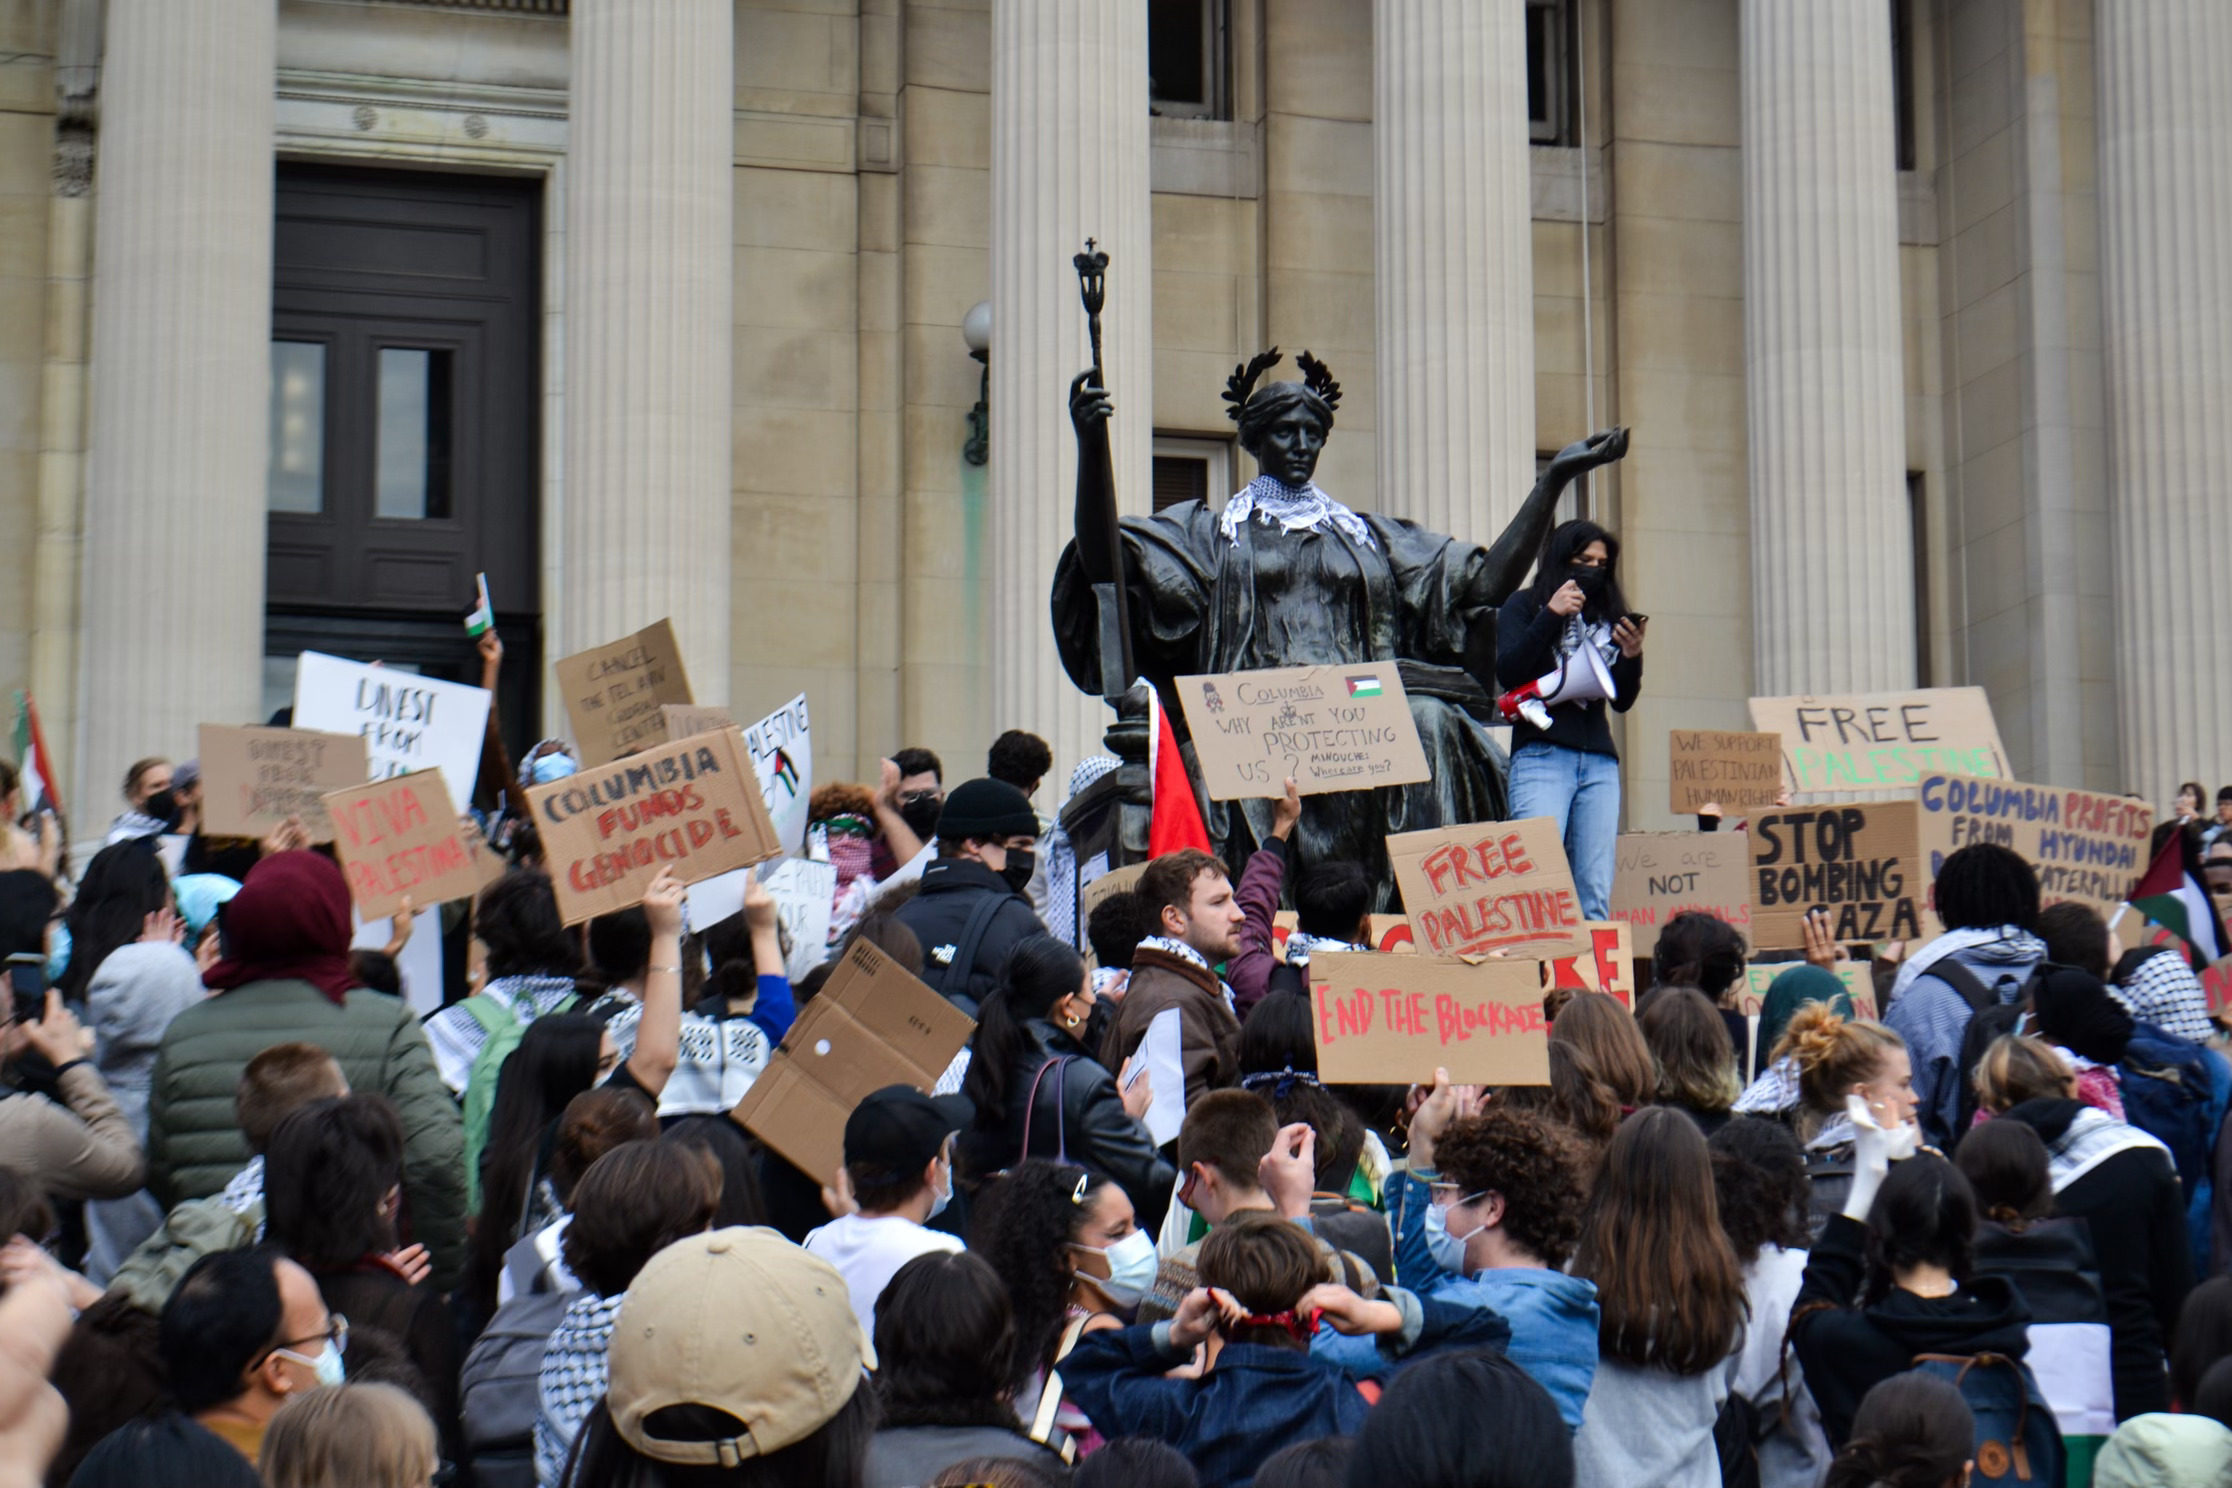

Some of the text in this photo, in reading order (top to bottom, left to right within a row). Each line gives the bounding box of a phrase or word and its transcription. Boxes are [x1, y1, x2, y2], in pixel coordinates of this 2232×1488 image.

[356, 677, 439, 725] DIVEST
[607, 682, 636, 701] TEL
[1237, 681, 1325, 706] COLUMBIA
[746, 699, 809, 764] ALESTINE
[1216, 716, 1251, 734] WHY
[1328, 706, 1366, 724] YOU
[1263, 726, 1397, 755] PROTECTING
[1676, 733, 1774, 752] WE SUPPORT
[1795, 704, 1940, 744] FREE
[1236, 753, 1299, 784] US ?
[1311, 751, 1370, 763] MINOUCHE:
[1672, 759, 1779, 780] PALESTINIAN
[1795, 748, 1997, 788] PALESTINE
[543, 746, 721, 823] COLUMBIA
[1685, 786, 1738, 807] HUMAN
[1921, 775, 2153, 840] COLUMBIA PROFITS
[331, 785, 429, 848] VIVA
[596, 783, 705, 841] FUNDS
[568, 807, 743, 893] GENOCIDE
[1615, 846, 1721, 872] We are
[1755, 808, 1867, 866] STOP
[1951, 814, 2137, 870] FROM HYUNDAI
[347, 834, 470, 908] PALESTINA
[1418, 830, 1540, 900] FREE
[1648, 872, 1700, 896] NOT
[1758, 856, 1904, 906] BOMBING
[1416, 887, 1580, 953] PALESTINE
[1316, 984, 1548, 1047] END THE BLOCKADE
